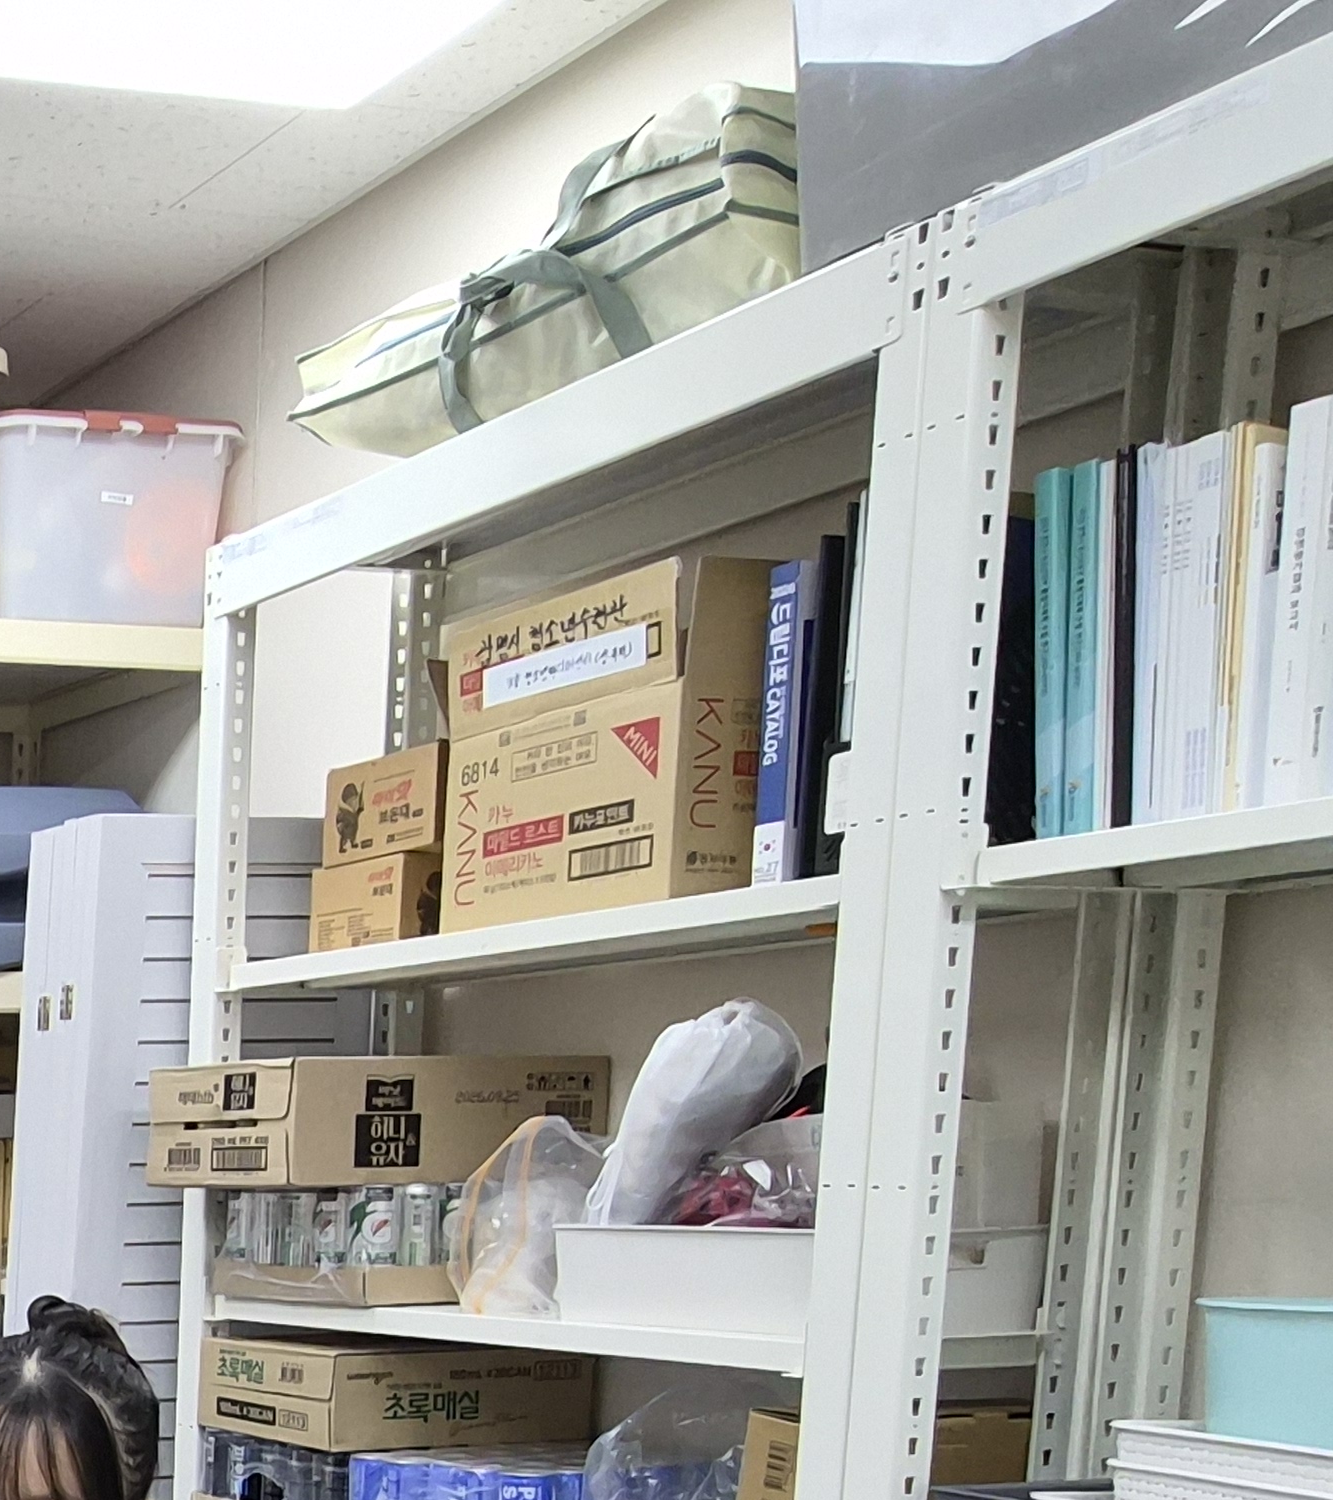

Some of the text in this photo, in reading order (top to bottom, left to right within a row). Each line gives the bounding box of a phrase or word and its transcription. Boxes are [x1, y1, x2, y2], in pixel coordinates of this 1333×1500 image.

[623, 726, 658, 767] MINI
[689, 697, 726, 829] KANU
[461, 757, 500, 787] 6814
[488, 804, 515, 825] 카누
[454, 789, 480, 907] KANU
[485, 820, 561, 854] 마일드 로스트
[369, 1141, 405, 1166] 유자
[216, 1355, 265, 1385] 초록매실
[382, 1389, 481, 1424] 초록매실
